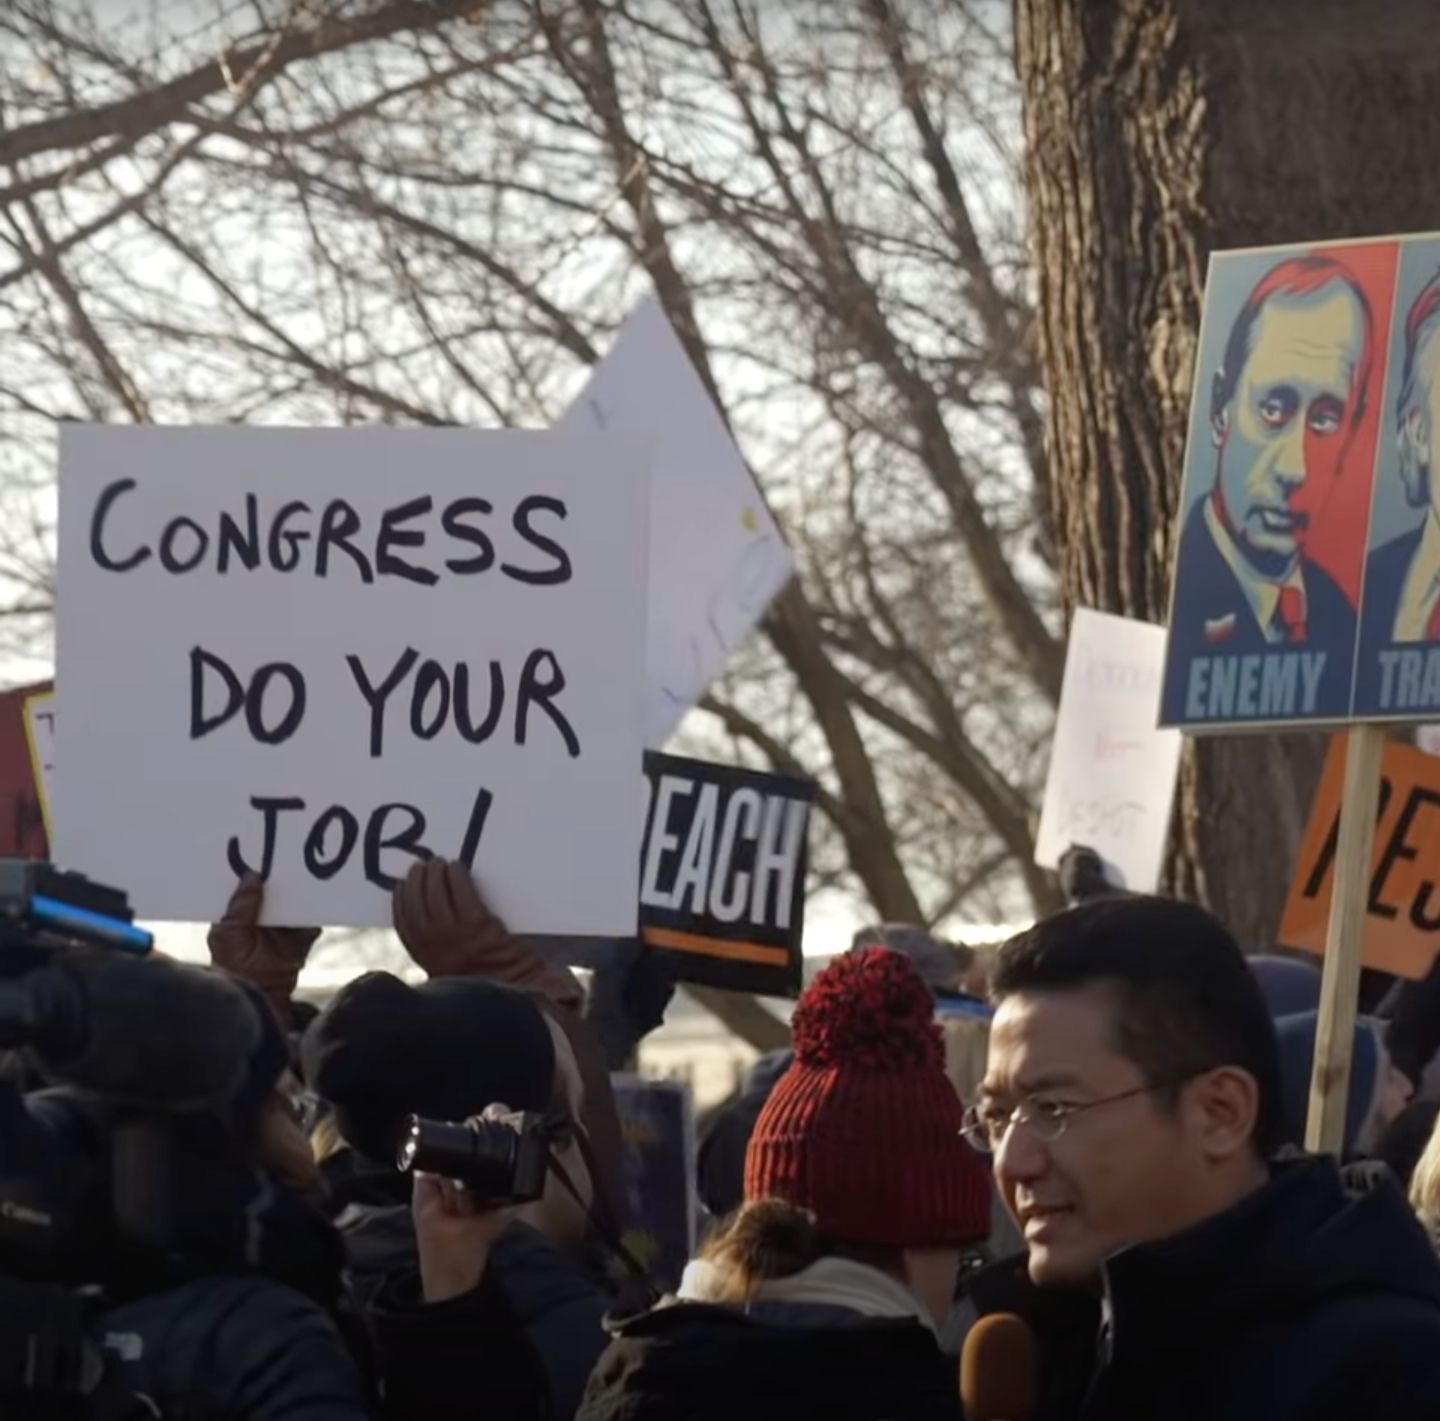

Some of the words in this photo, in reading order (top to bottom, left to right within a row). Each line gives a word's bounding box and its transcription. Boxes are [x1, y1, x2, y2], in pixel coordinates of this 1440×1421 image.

[90, 477, 573, 587] CONGRESS
[190, 645, 307, 745] DO
[345, 645, 581, 758] YOUR
[1184, 651, 1327, 719] ENEMY
[640, 772, 810, 930] EACH
